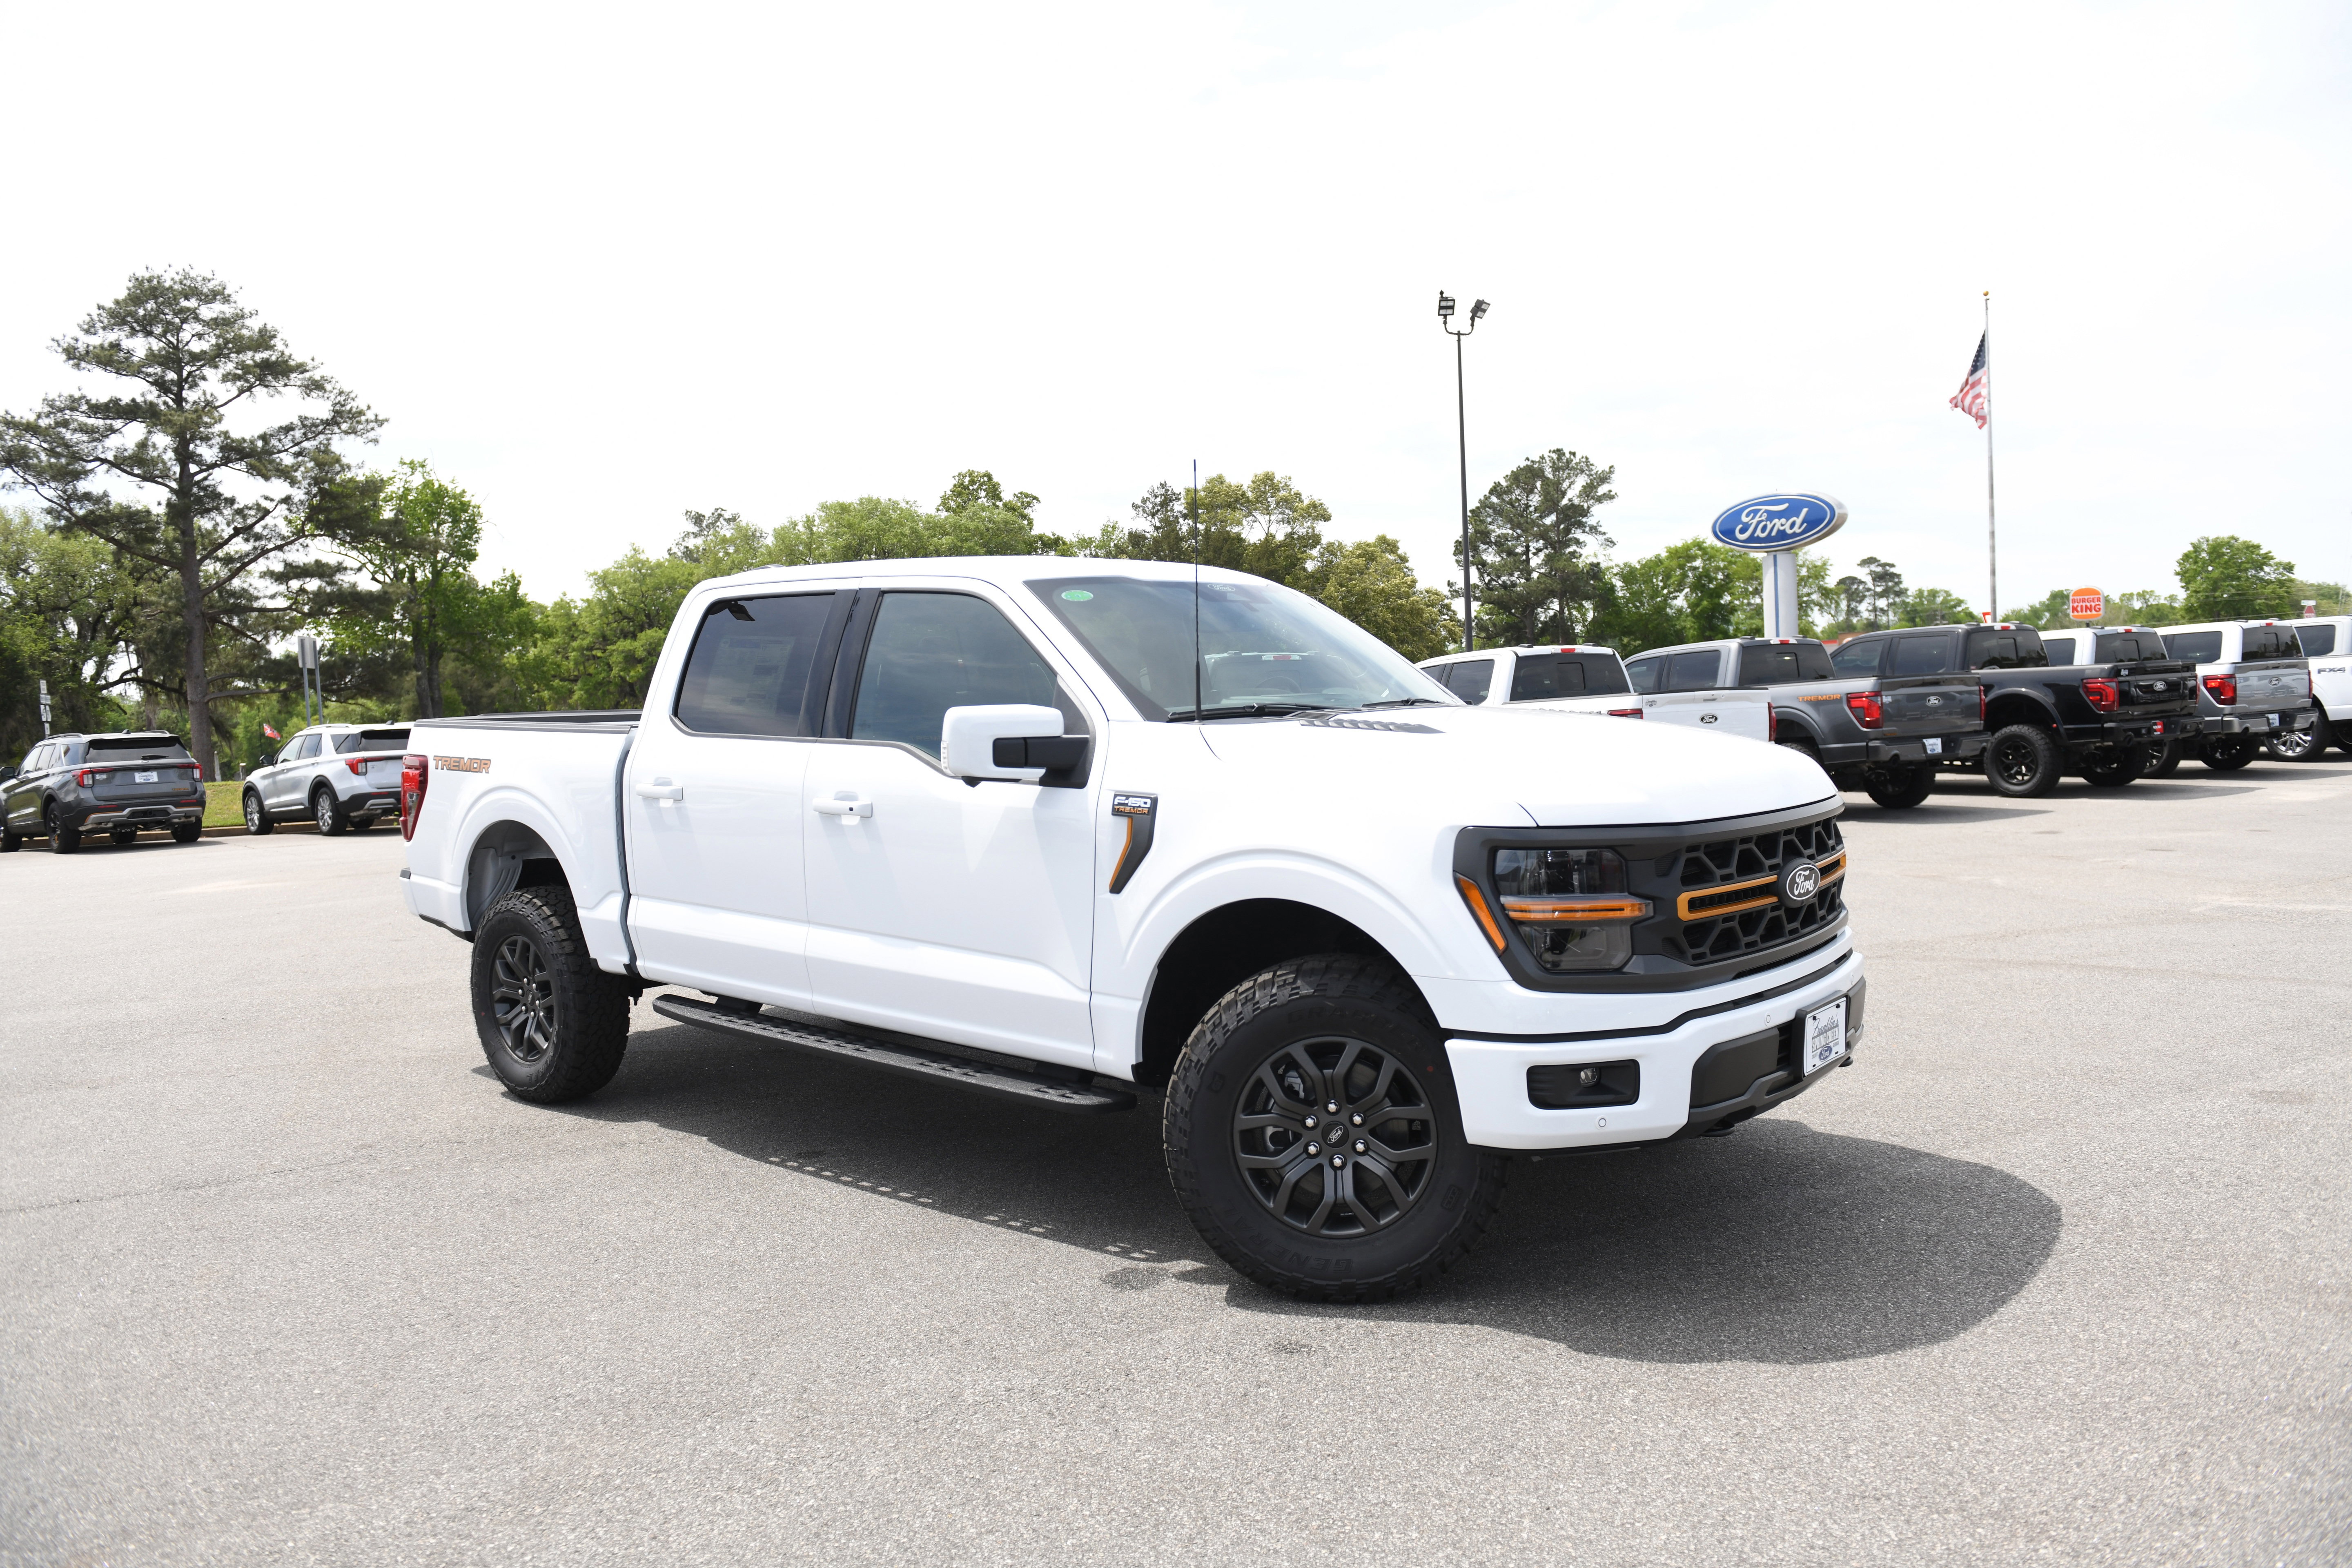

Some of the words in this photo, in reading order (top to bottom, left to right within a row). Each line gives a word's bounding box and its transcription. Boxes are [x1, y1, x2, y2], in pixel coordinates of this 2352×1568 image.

[1735, 503, 1809, 540] Ford
[2072, 604, 2101, 613] KING
[433, 755, 491, 774] TREMOR
[1114, 796, 1151, 808] F-150
[1794, 870, 1815, 895] Ford
[1813, 1013, 1839, 1037] Franklin's
[1812, 1034, 1826, 1051] SPRING
[1826, 1028, 1839, 1043] CREEK
[1821, 1047, 1830, 1059] Ford
[1330, 1129, 1341, 1141] Ford
